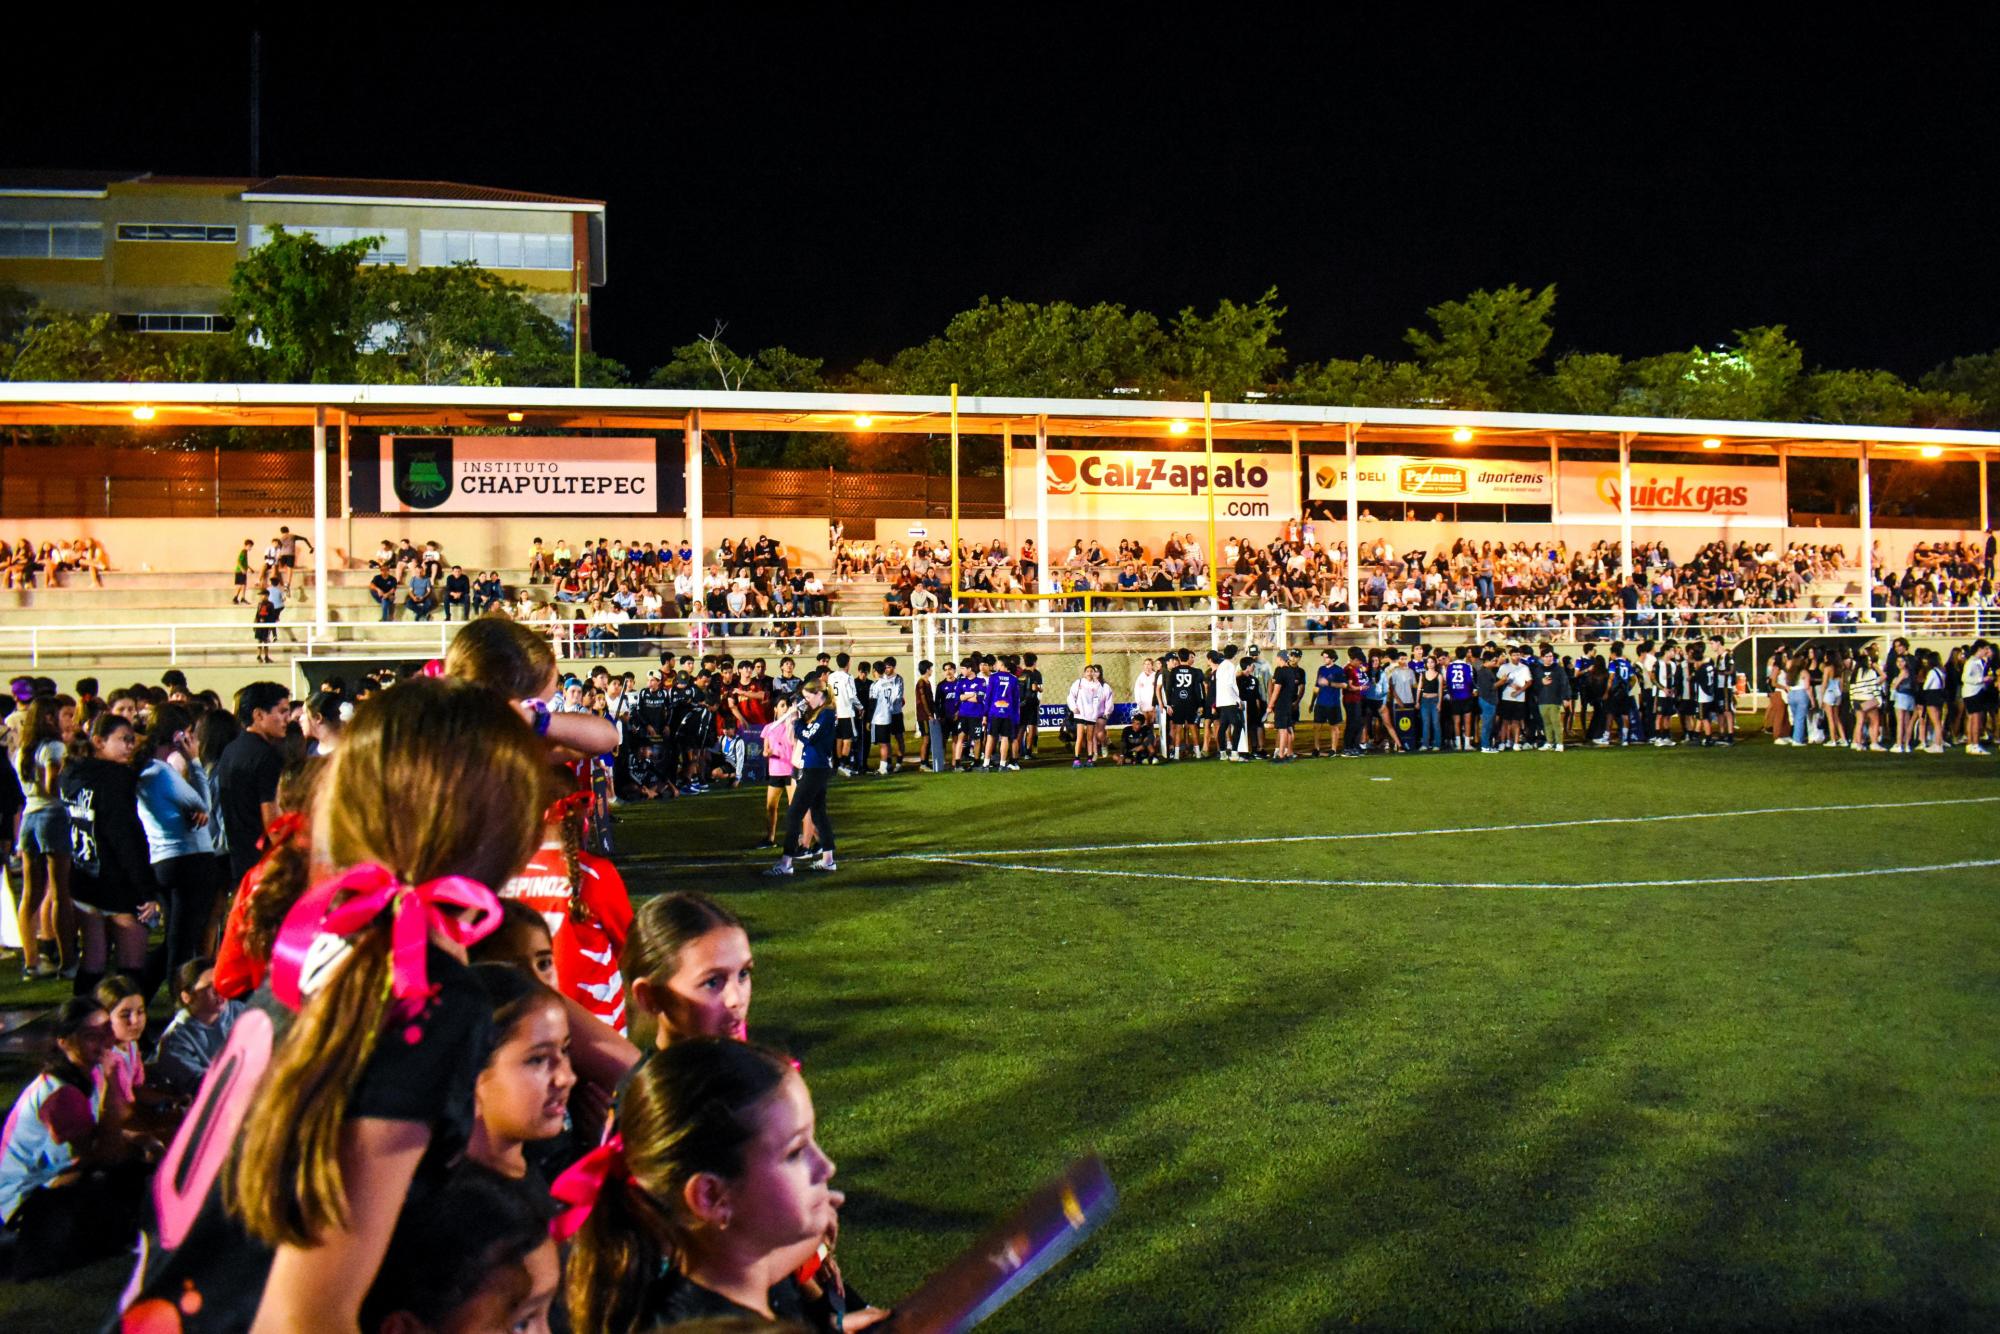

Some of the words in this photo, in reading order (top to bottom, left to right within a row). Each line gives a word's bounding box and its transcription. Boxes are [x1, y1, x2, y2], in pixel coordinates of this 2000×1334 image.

[463, 462, 559, 473] INSTITUTO
[1340, 471, 1386, 482] RDELI
[1477, 471, 1544, 485] dportenis
[460, 476, 646, 495] CHAPULTEPEC
[1222, 501, 1269, 517] .com
[1175, 673, 1193, 688] 99
[1451, 669, 1465, 683] 23
[999, 681, 1010, 698] 7
